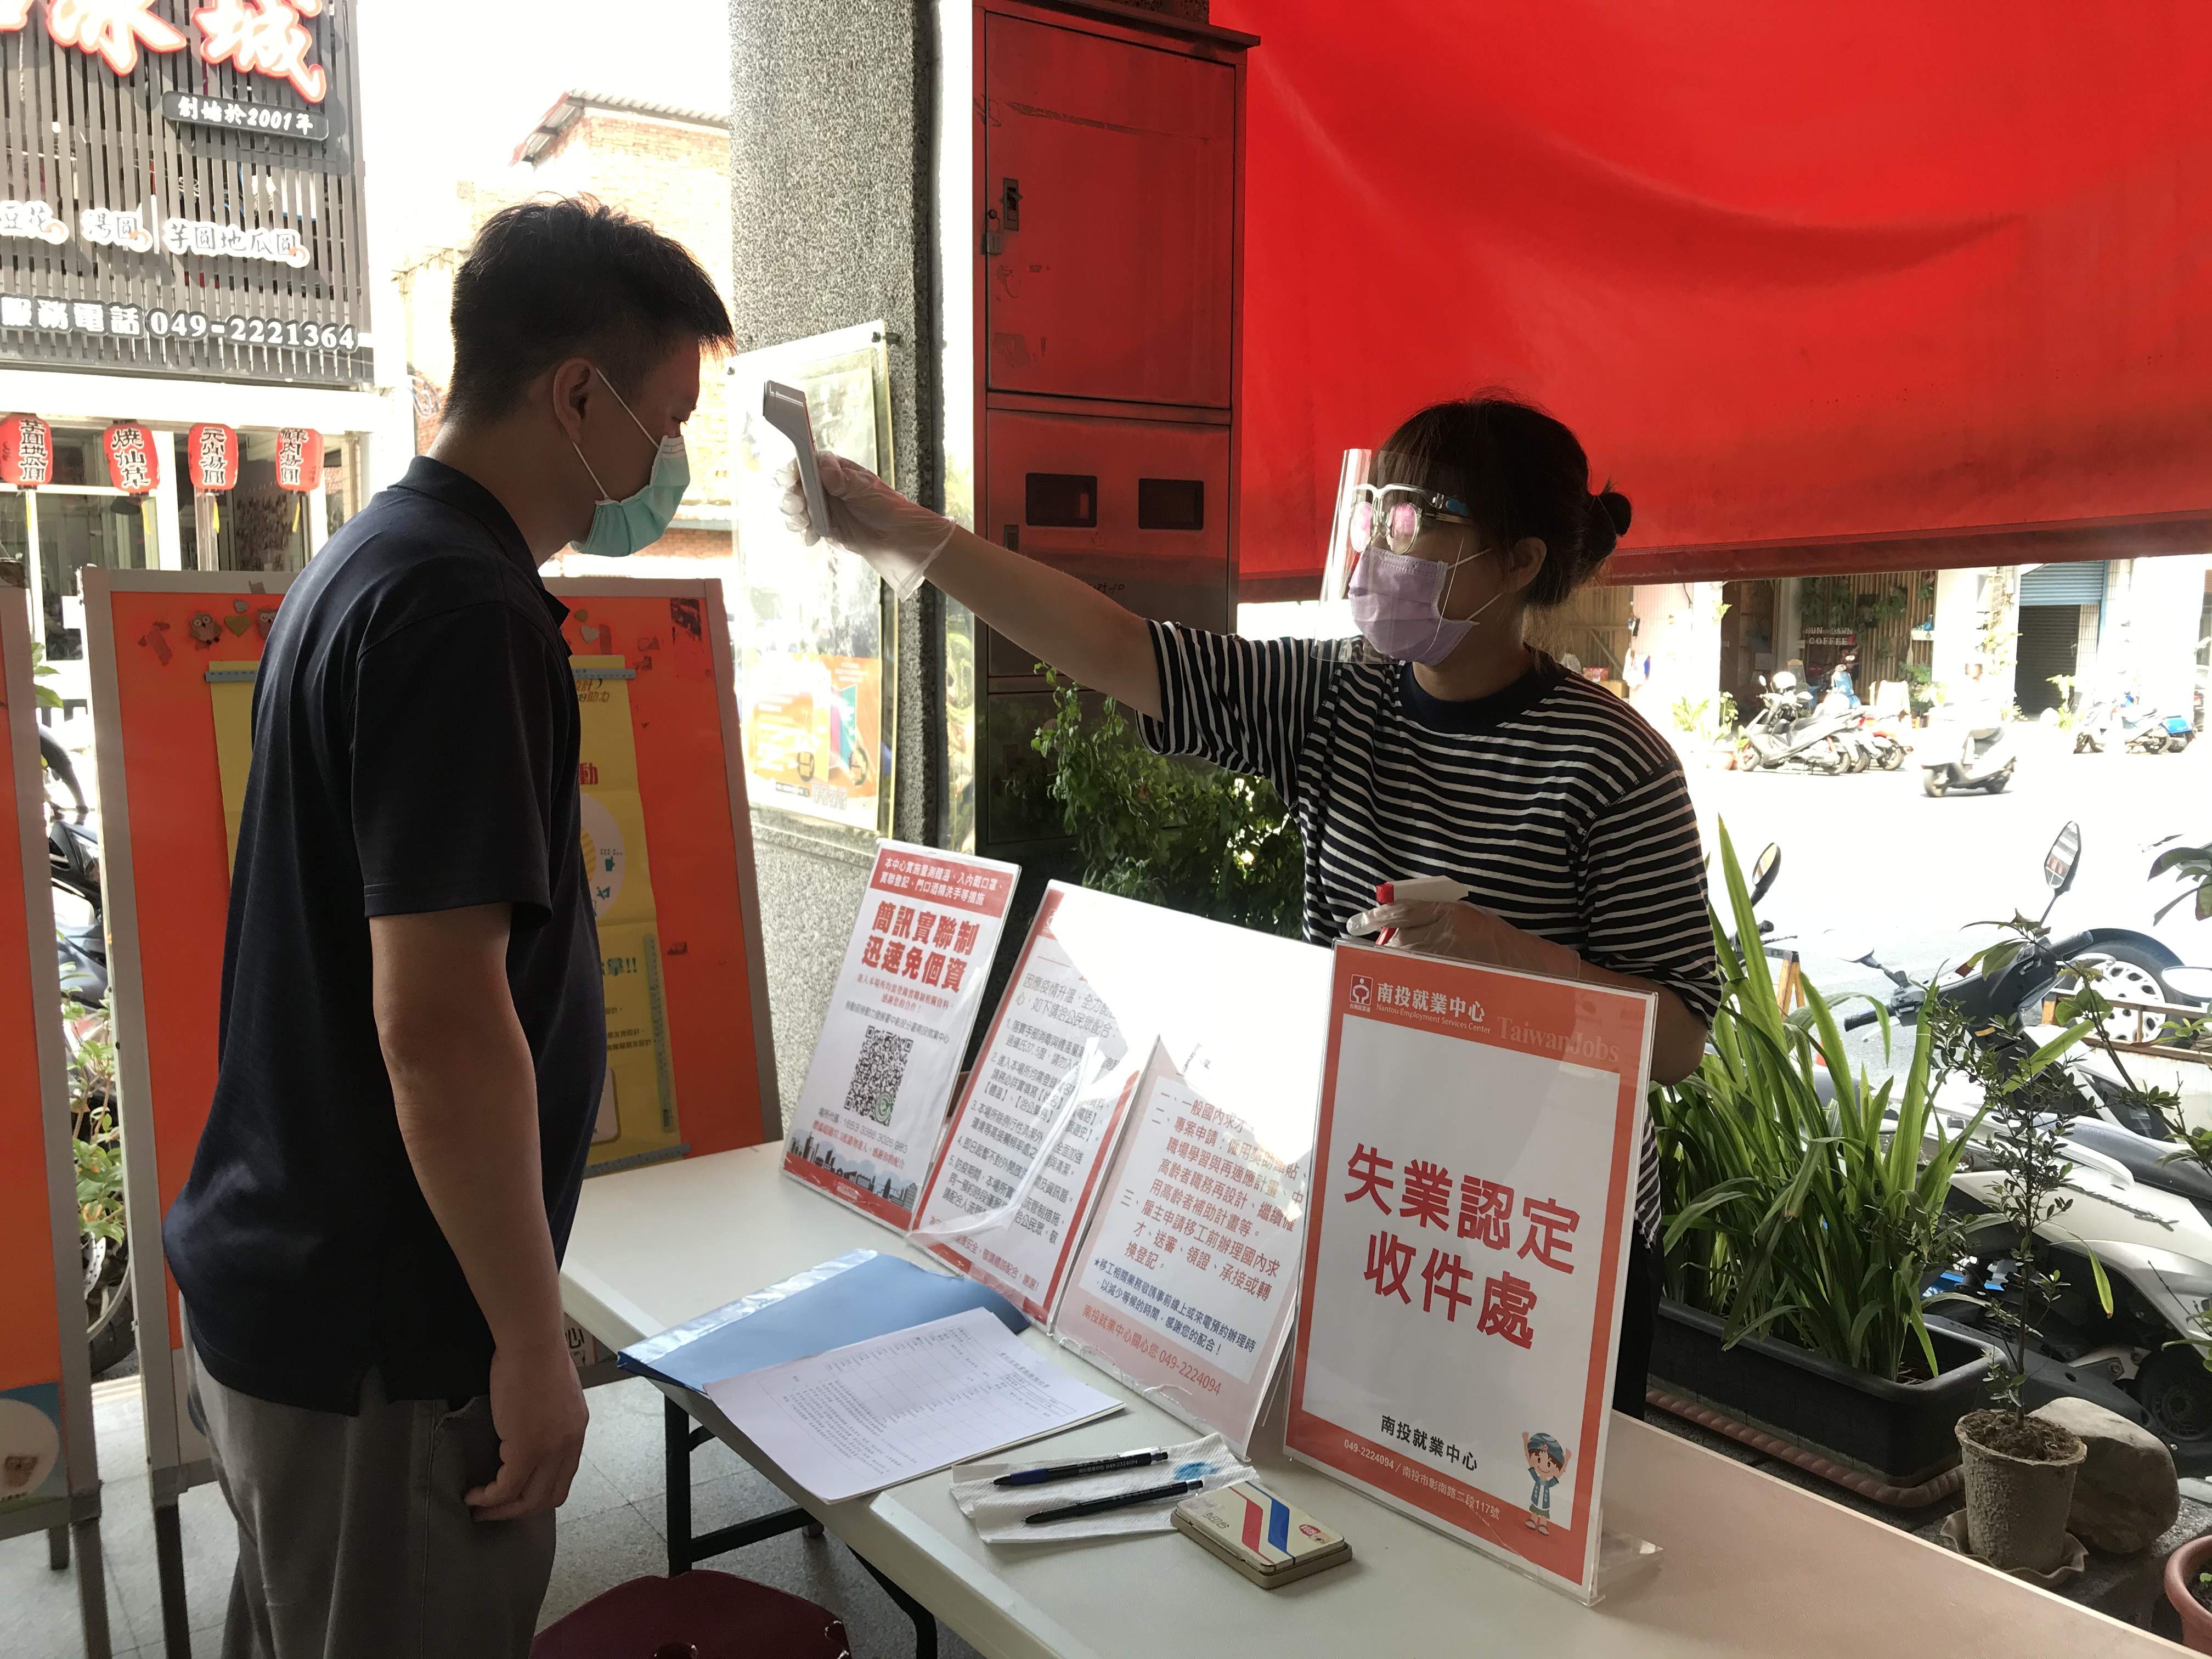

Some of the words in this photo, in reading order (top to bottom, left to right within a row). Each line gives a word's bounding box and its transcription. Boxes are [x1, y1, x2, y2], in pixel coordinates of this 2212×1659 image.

[178, 95, 313, 136] 創始於2001年
[169, 222, 298, 257] 芋圓地瓜圓
[150, 311, 355, 350] 049-2221364
[872, 900, 980, 956] 簡訊實聯制
[861, 934, 968, 993] 迅速免個資
[1376, 1003, 1399, 1014] Nantou
[1400, 1009, 1441, 1023] Employment
[1441, 1017, 1467, 1029] Services
[1469, 1023, 1491, 1034] Center
[1378, 983, 1485, 1022] 南投就業中心
[1497, 1016, 1619, 1063] TaiwanJobs
[1149, 1178, 1259, 1237] 用高齡者補助計畫等。
[1344, 1143, 1580, 1276] 失業認定
[1125, 1240, 1164, 1270] 換登記。
[1363, 1231, 1539, 1350] 收件處
[1082, 1304, 1159, 1359] 南投就業中心關心您
[1159, 1350, 1222, 1396] 049-2224094
[1381, 1415, 1477, 1472] 南投就業中心
[1344, 1440, 1394, 1470] 049-2224094
[1402, 1465, 1500, 1520] 南投市彰南路二段117號
